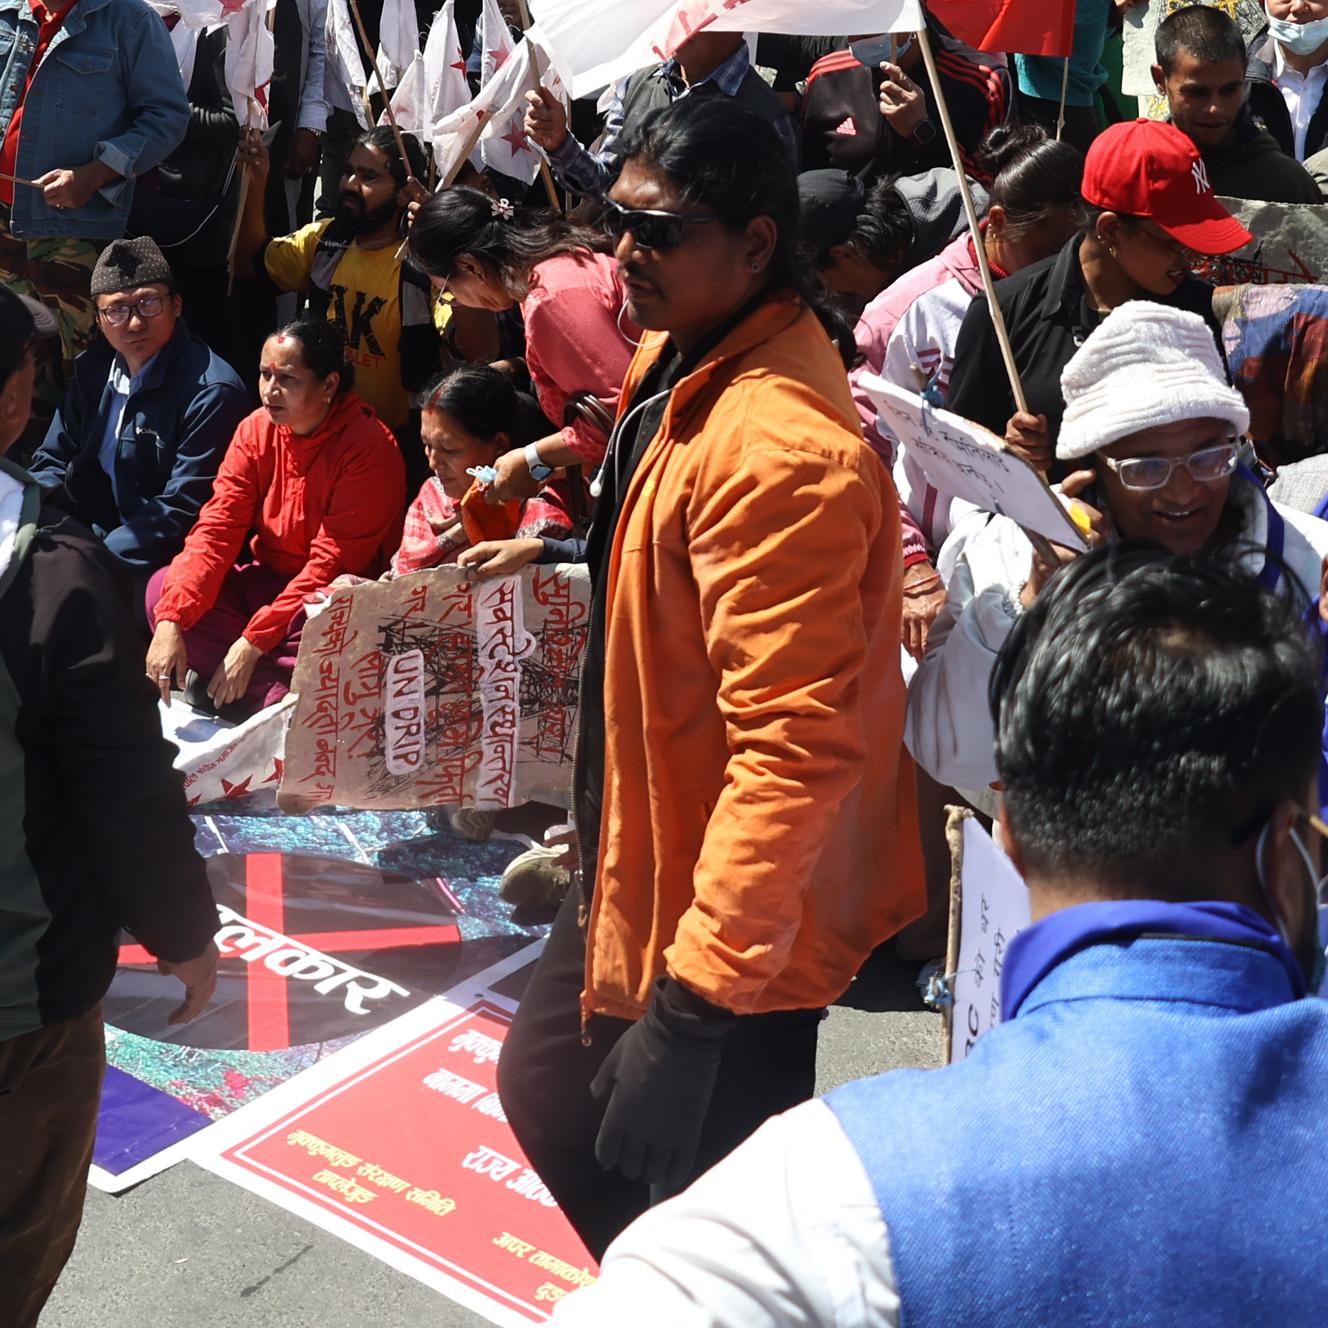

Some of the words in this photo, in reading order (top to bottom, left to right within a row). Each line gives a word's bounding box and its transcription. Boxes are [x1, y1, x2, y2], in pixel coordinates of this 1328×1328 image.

[390, 653, 419, 699] UN
[390, 706, 420, 767] DRIP
[461, 1144, 521, 1183] राज्य
[356, 1162, 411, 1194] संरक्षण
[405, 1185, 457, 1217] समिति
